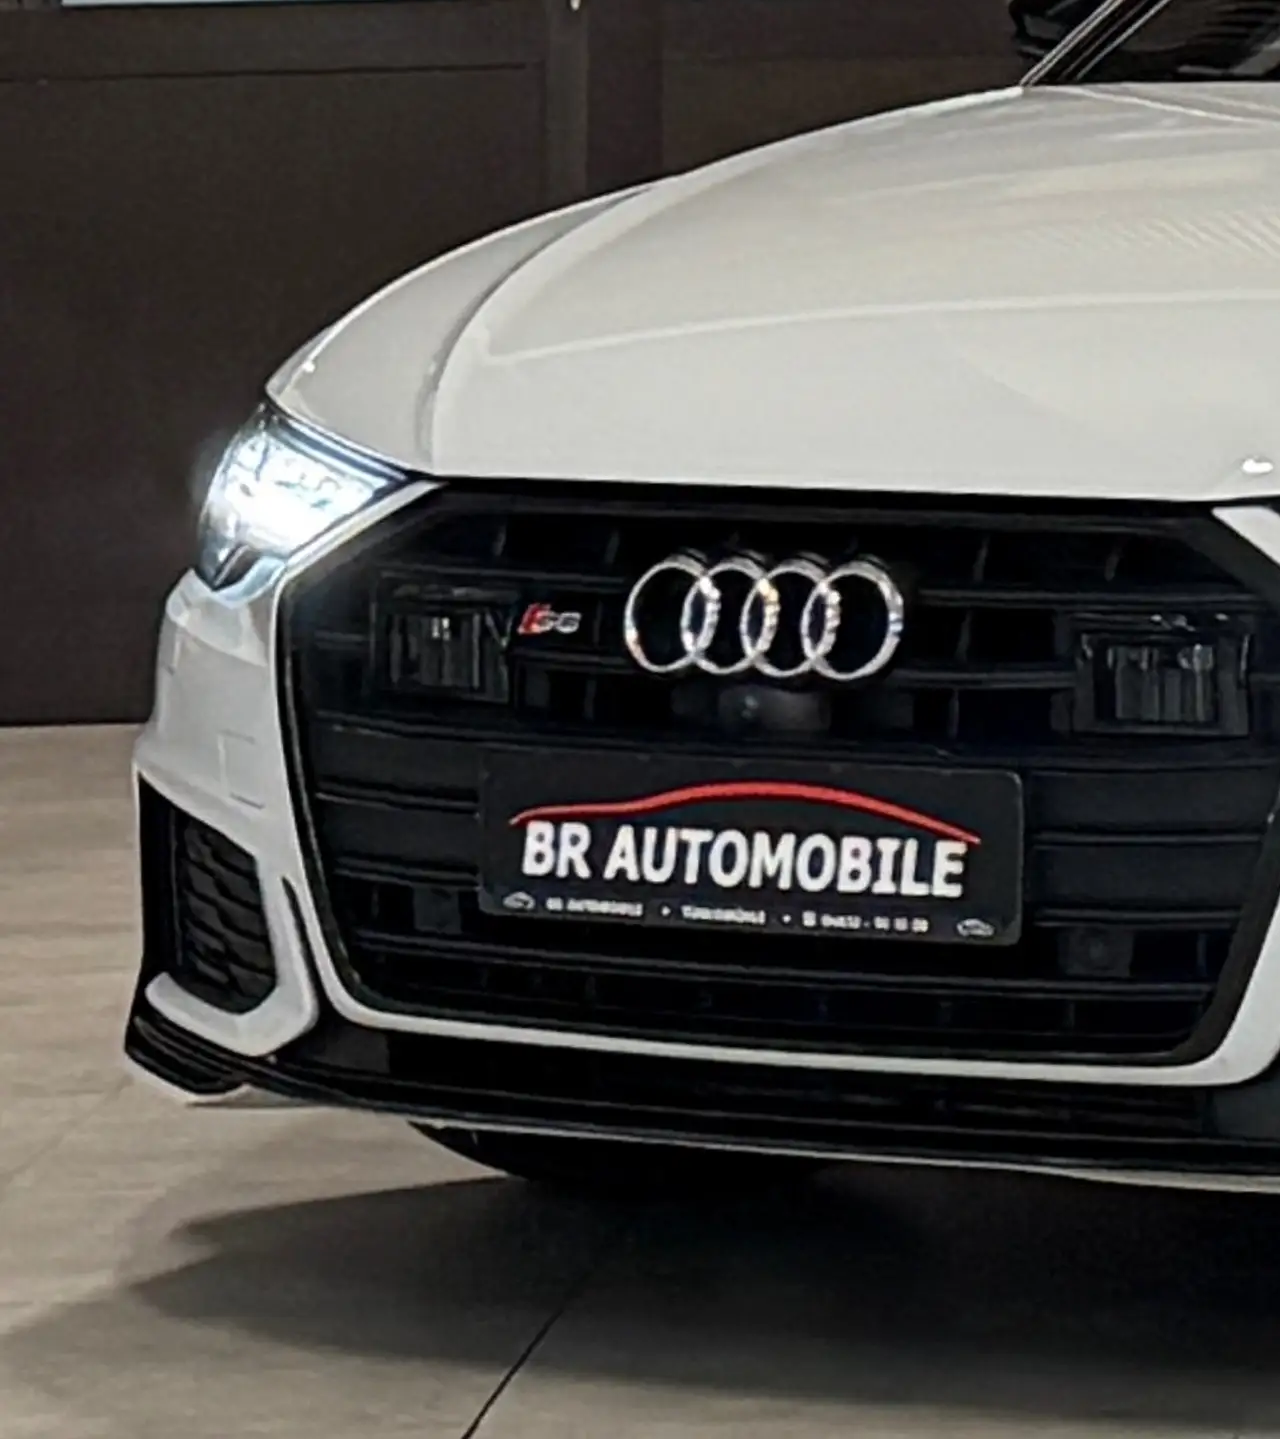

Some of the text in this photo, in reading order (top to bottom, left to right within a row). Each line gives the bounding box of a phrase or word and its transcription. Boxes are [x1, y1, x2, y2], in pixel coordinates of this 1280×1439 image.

[517, 603, 581, 634] S6
[522, 820, 968, 897] BR AUTOMOBILE
